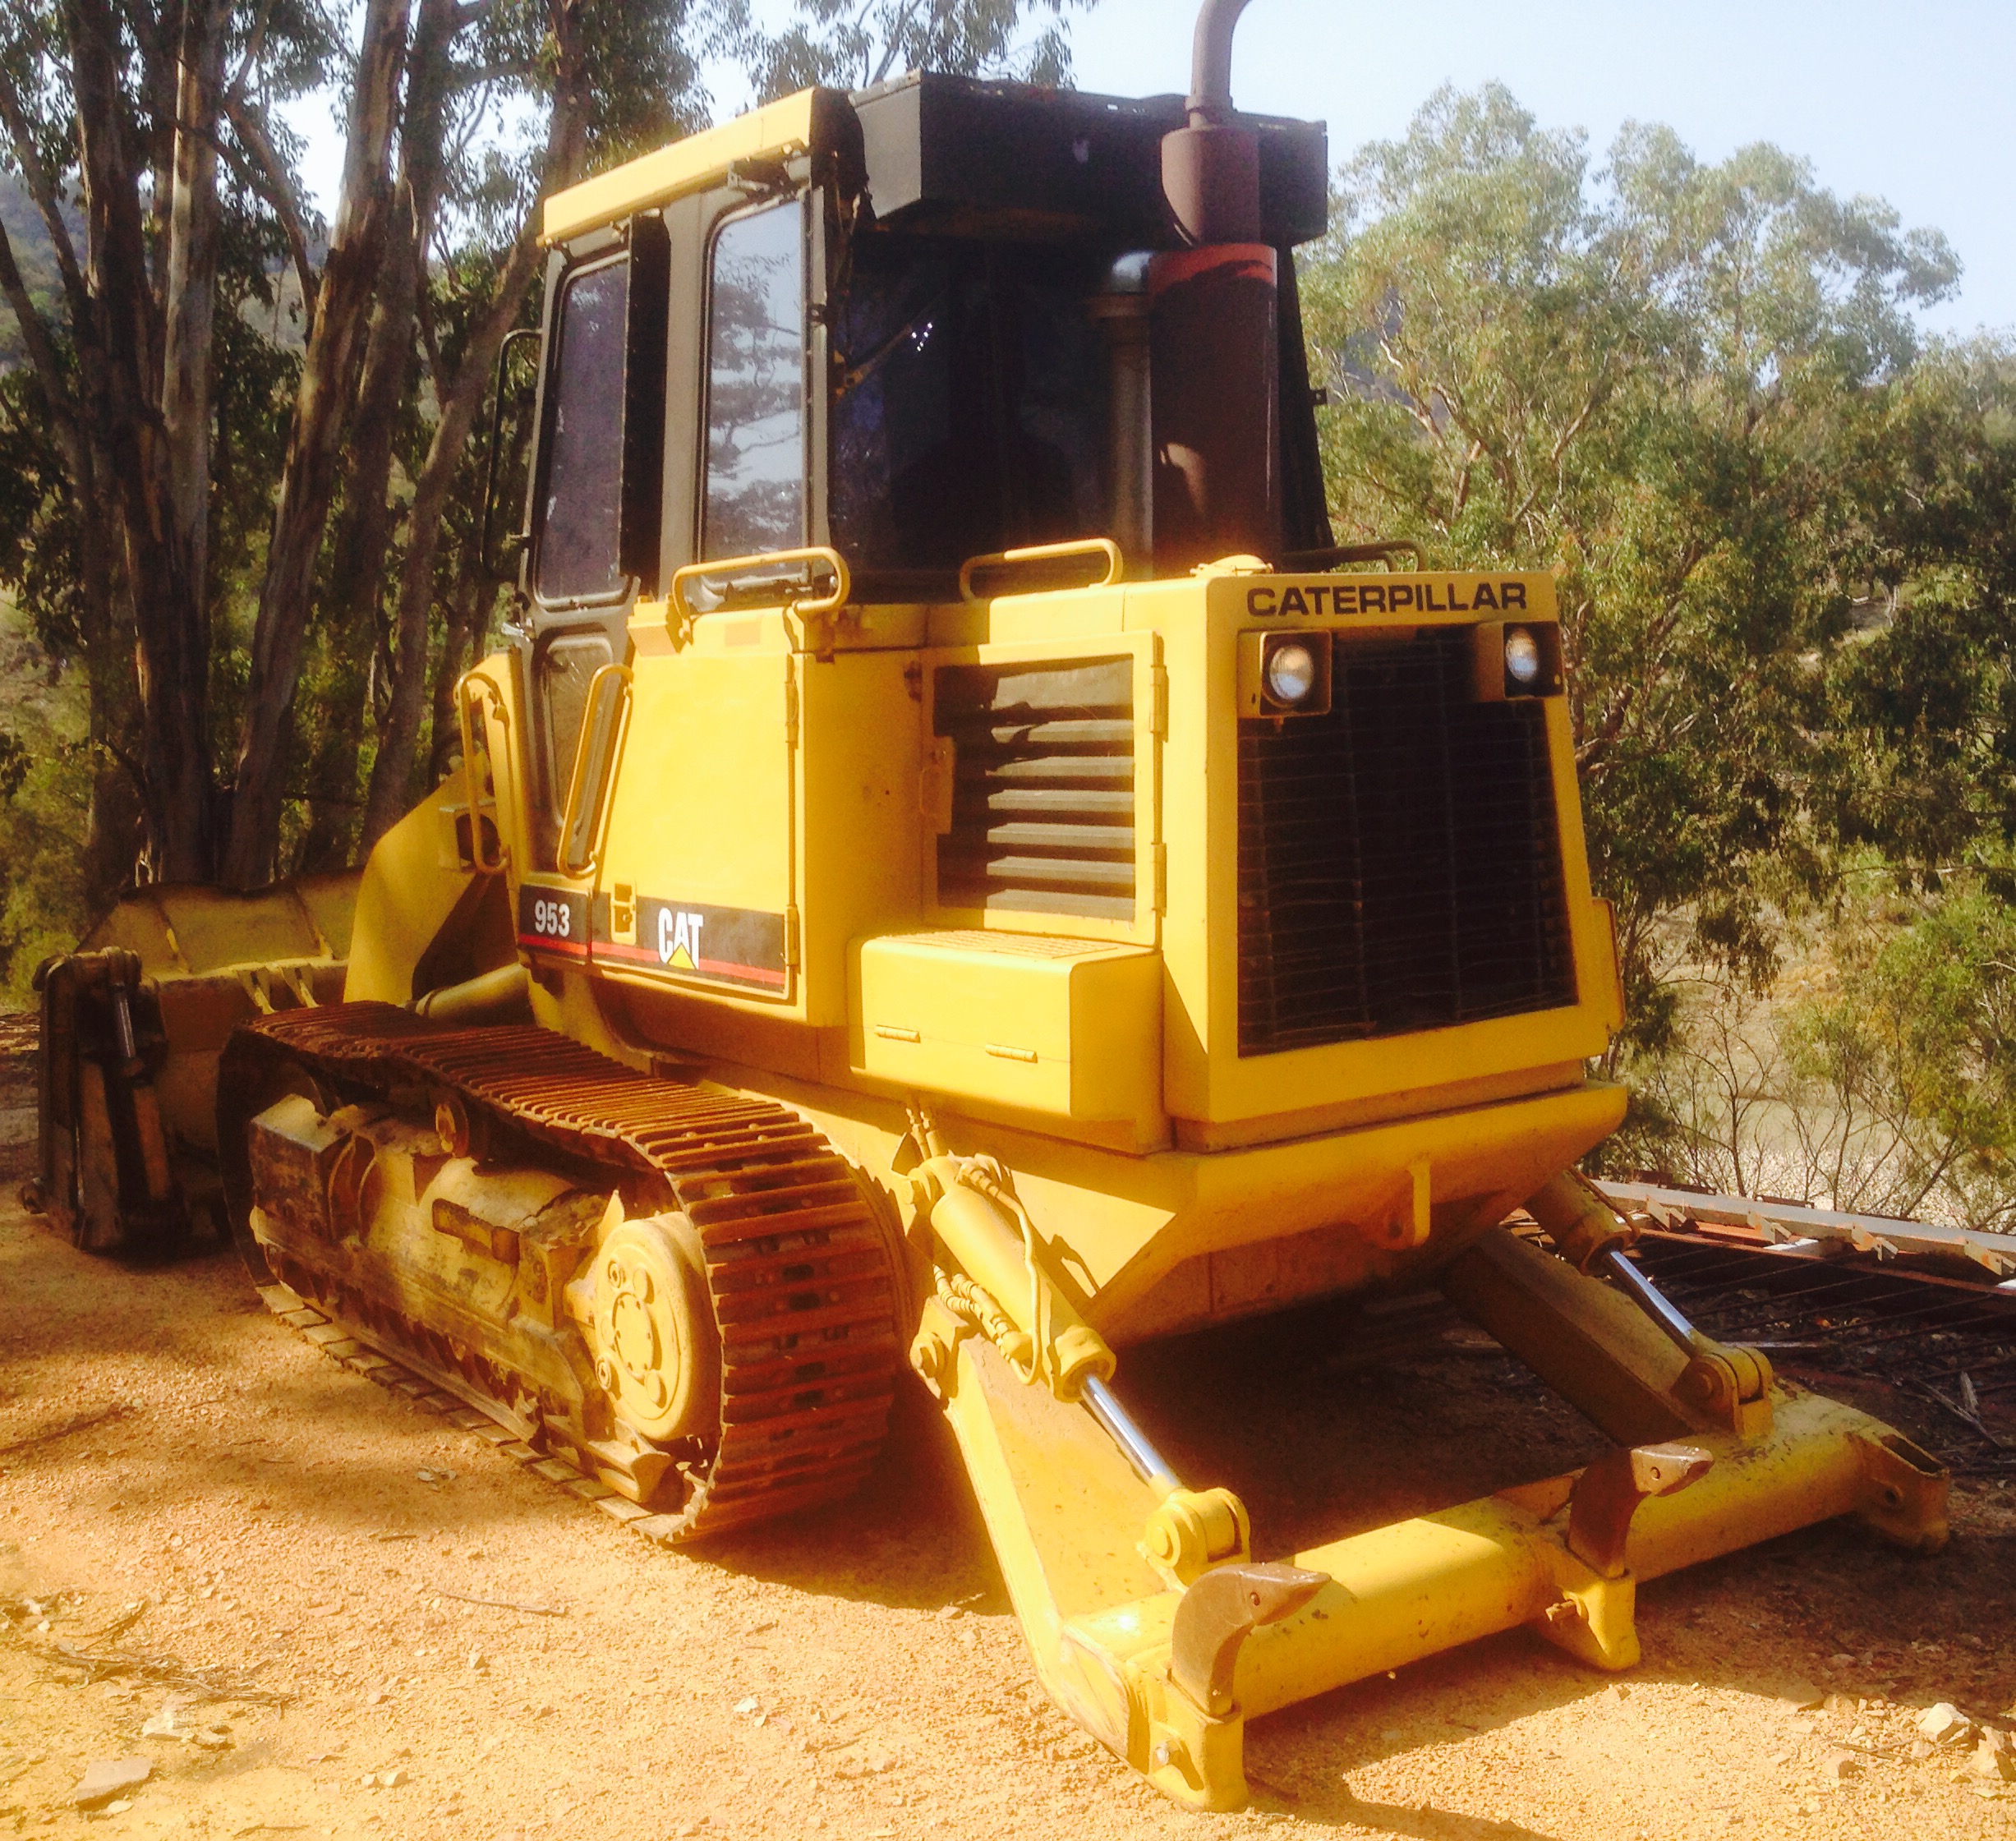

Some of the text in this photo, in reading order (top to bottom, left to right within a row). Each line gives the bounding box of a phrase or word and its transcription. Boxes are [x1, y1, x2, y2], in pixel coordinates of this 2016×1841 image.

[1247, 582, 1526, 617] CATERPILLAR
[535, 900, 570, 937] 953
[658, 908, 704, 969] CAT
